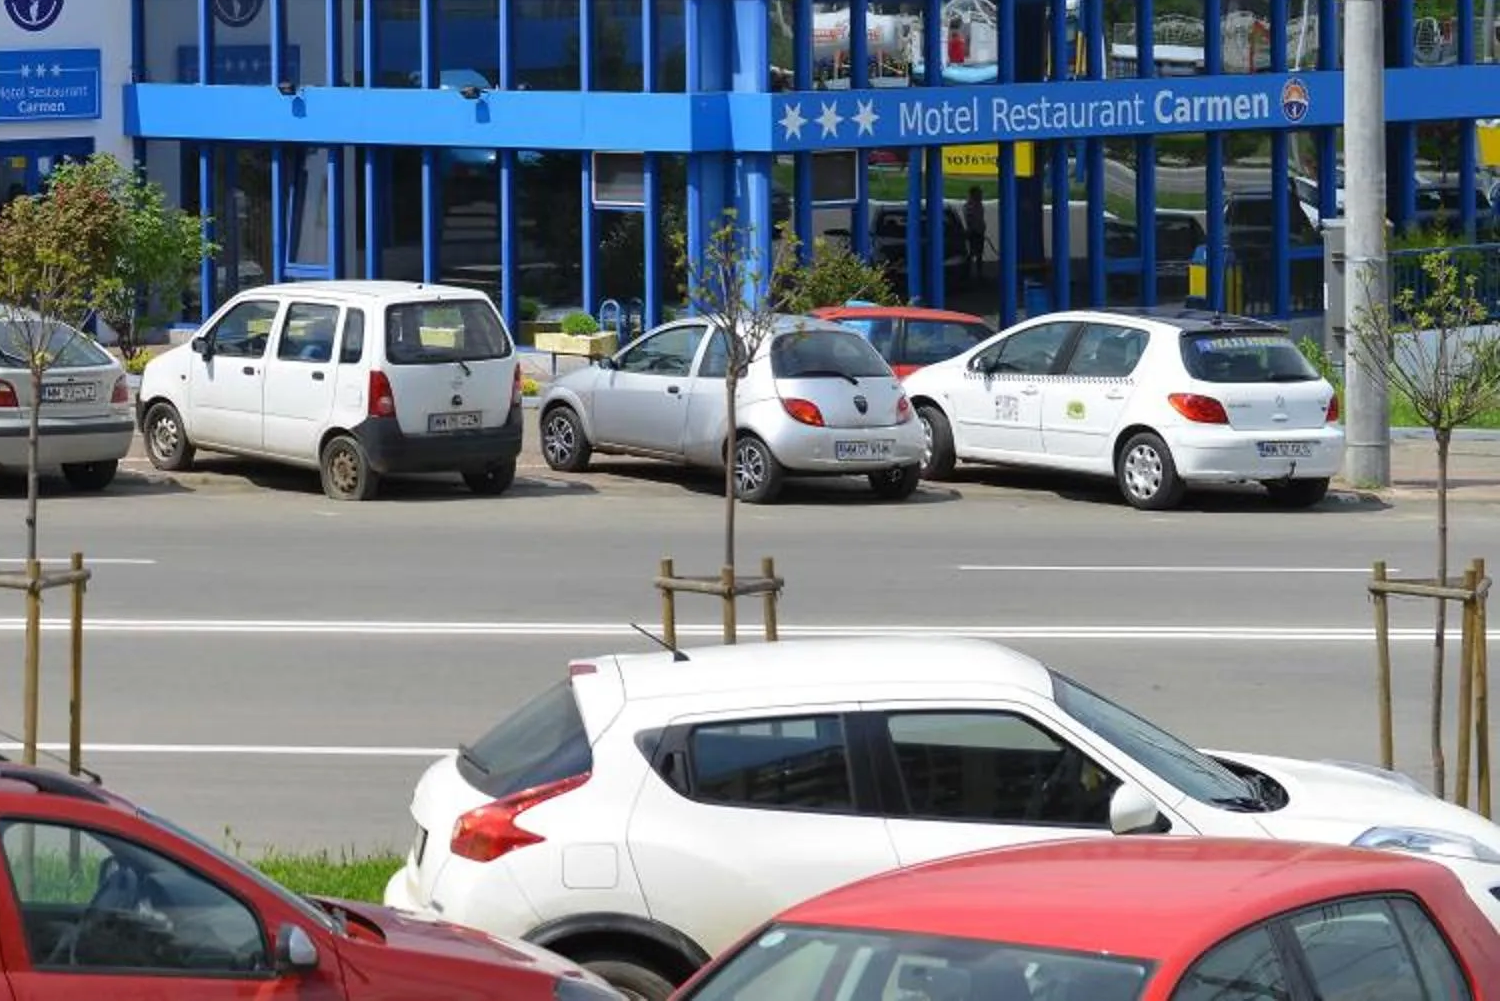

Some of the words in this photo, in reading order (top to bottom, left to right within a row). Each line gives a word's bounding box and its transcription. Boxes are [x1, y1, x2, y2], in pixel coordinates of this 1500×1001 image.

[28, 85, 88, 100] Restaurant
[17, 100, 66, 114] Carmen
[899, 95, 980, 137] Motel
[991, 92, 1146, 134] Restaurant
[1153, 89, 1270, 124] Carmen
